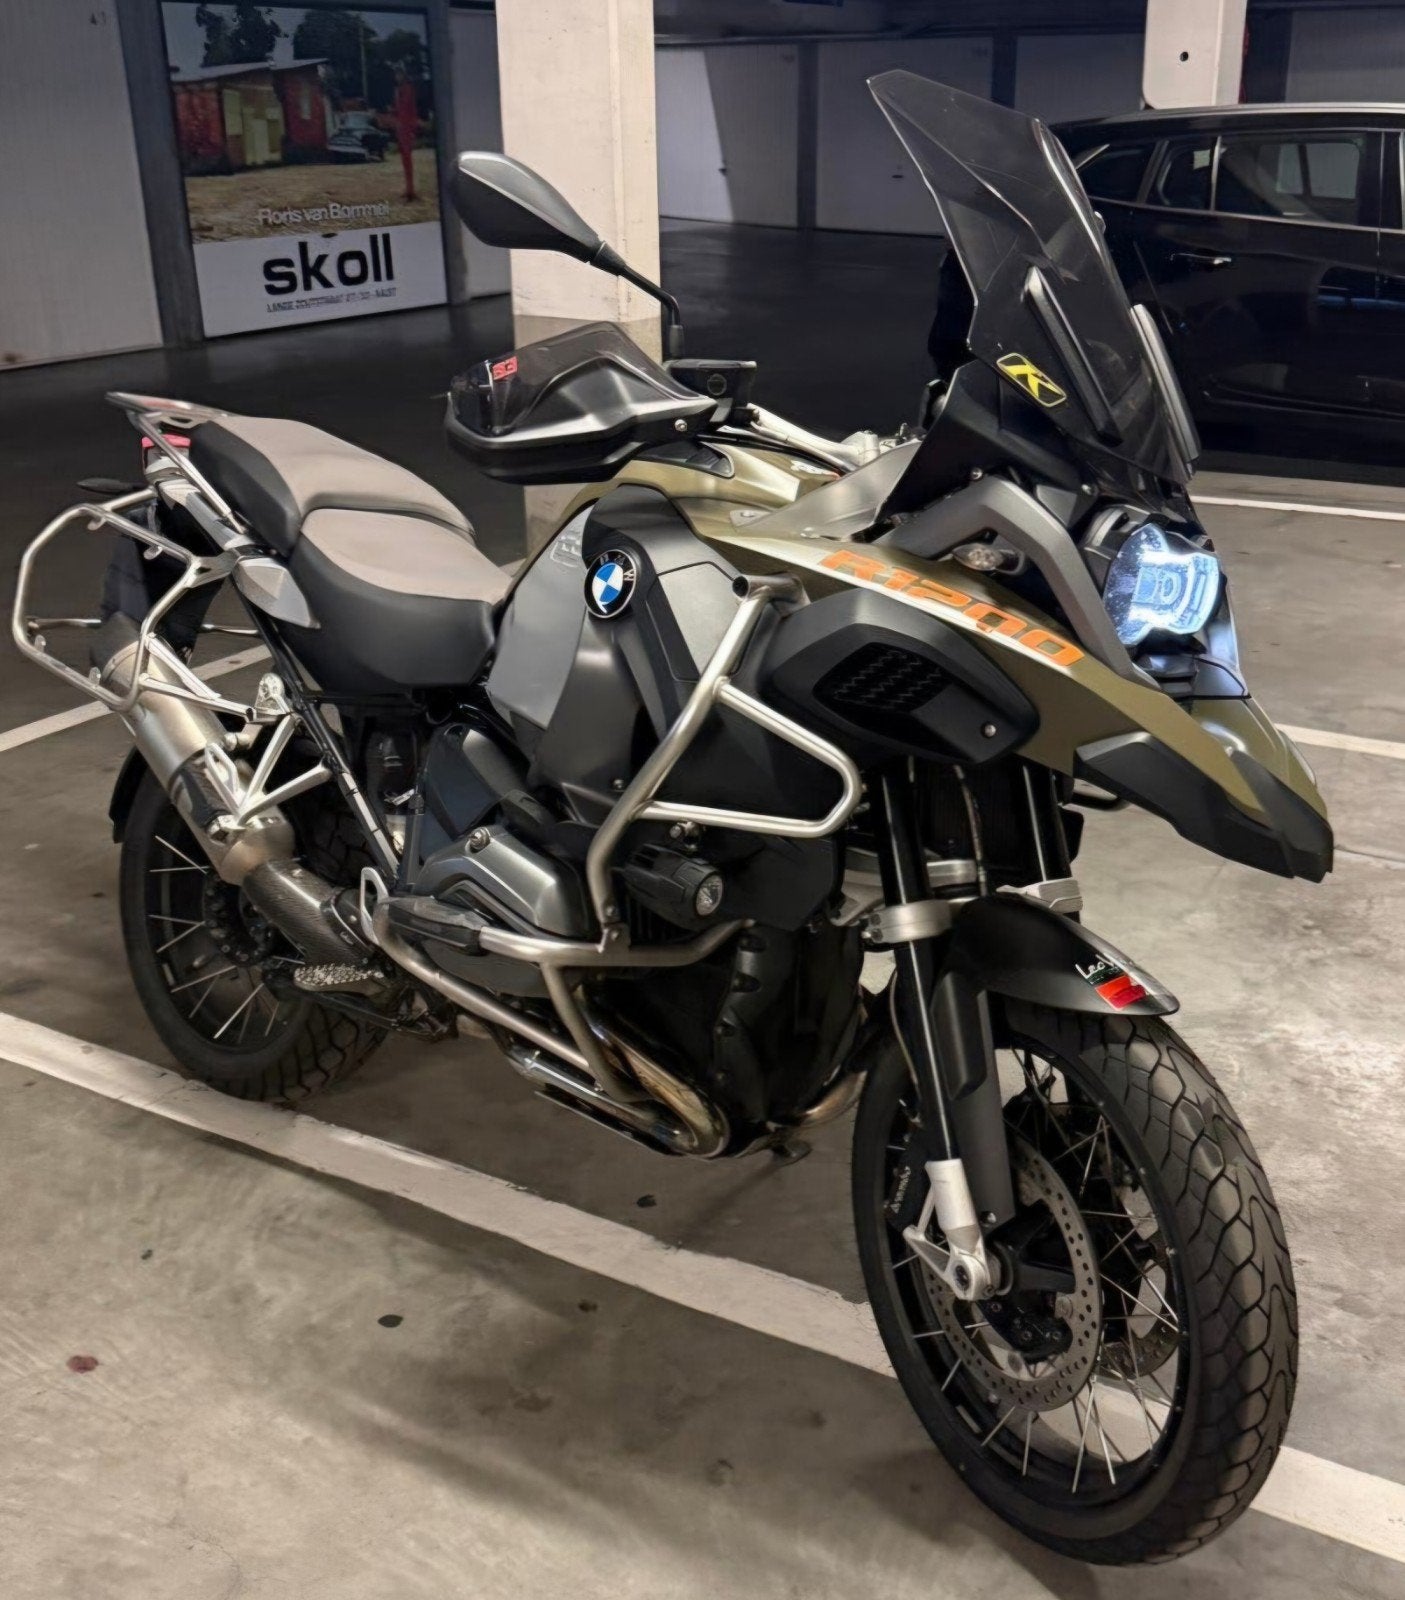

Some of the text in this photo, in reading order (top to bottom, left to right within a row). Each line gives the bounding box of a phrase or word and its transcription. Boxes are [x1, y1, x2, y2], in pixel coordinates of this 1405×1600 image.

[302, 207, 328, 221] van
[262, 232, 395, 296] skoll
[819, 549, 1085, 667] R1200
